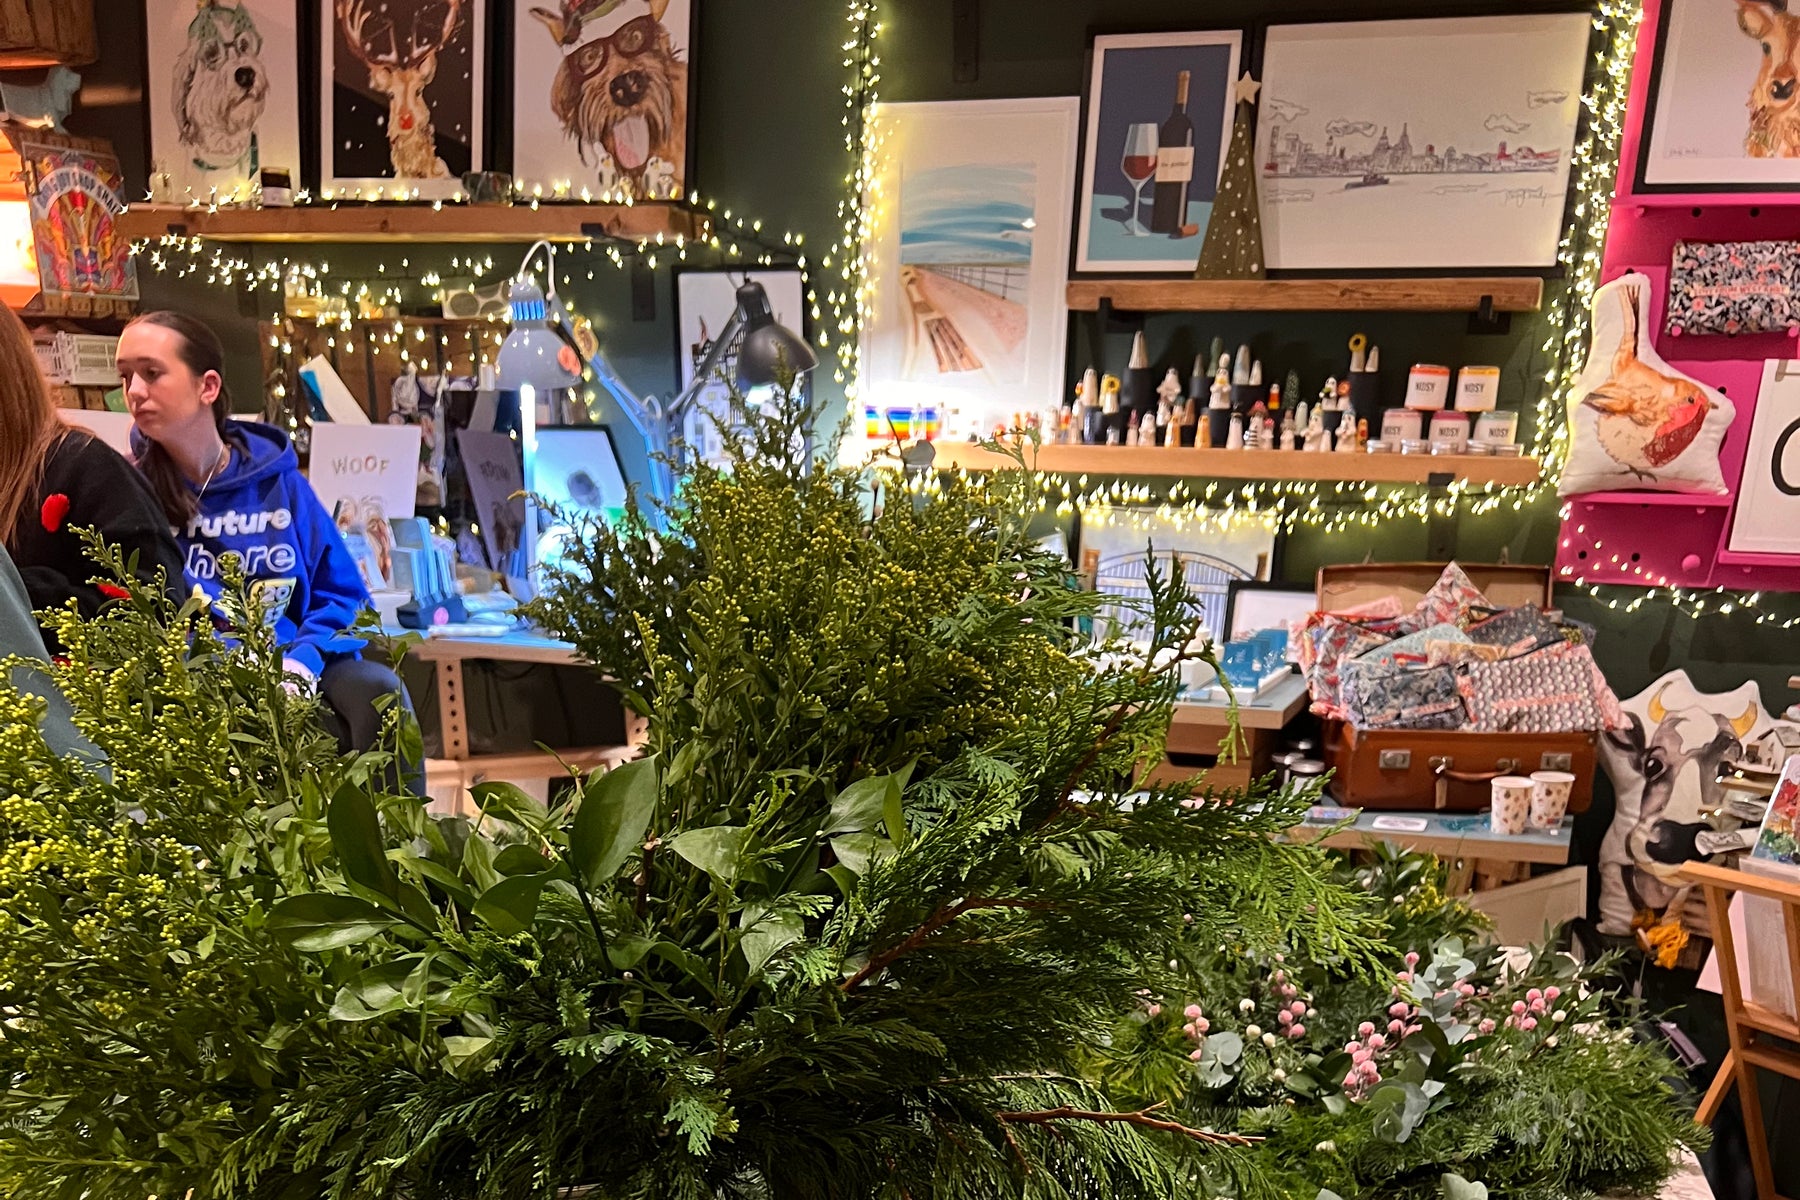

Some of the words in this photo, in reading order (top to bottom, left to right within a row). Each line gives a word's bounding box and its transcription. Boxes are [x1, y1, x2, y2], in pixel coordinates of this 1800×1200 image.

[1415, 381, 1436, 393] NOSY
[1464, 382, 1485, 393] NOSY
[1438, 427, 1459, 437] NOSY
[1488, 427, 1510, 438] NOSY
[332, 455, 391, 476] WOOF
[187, 508, 292, 538] future
